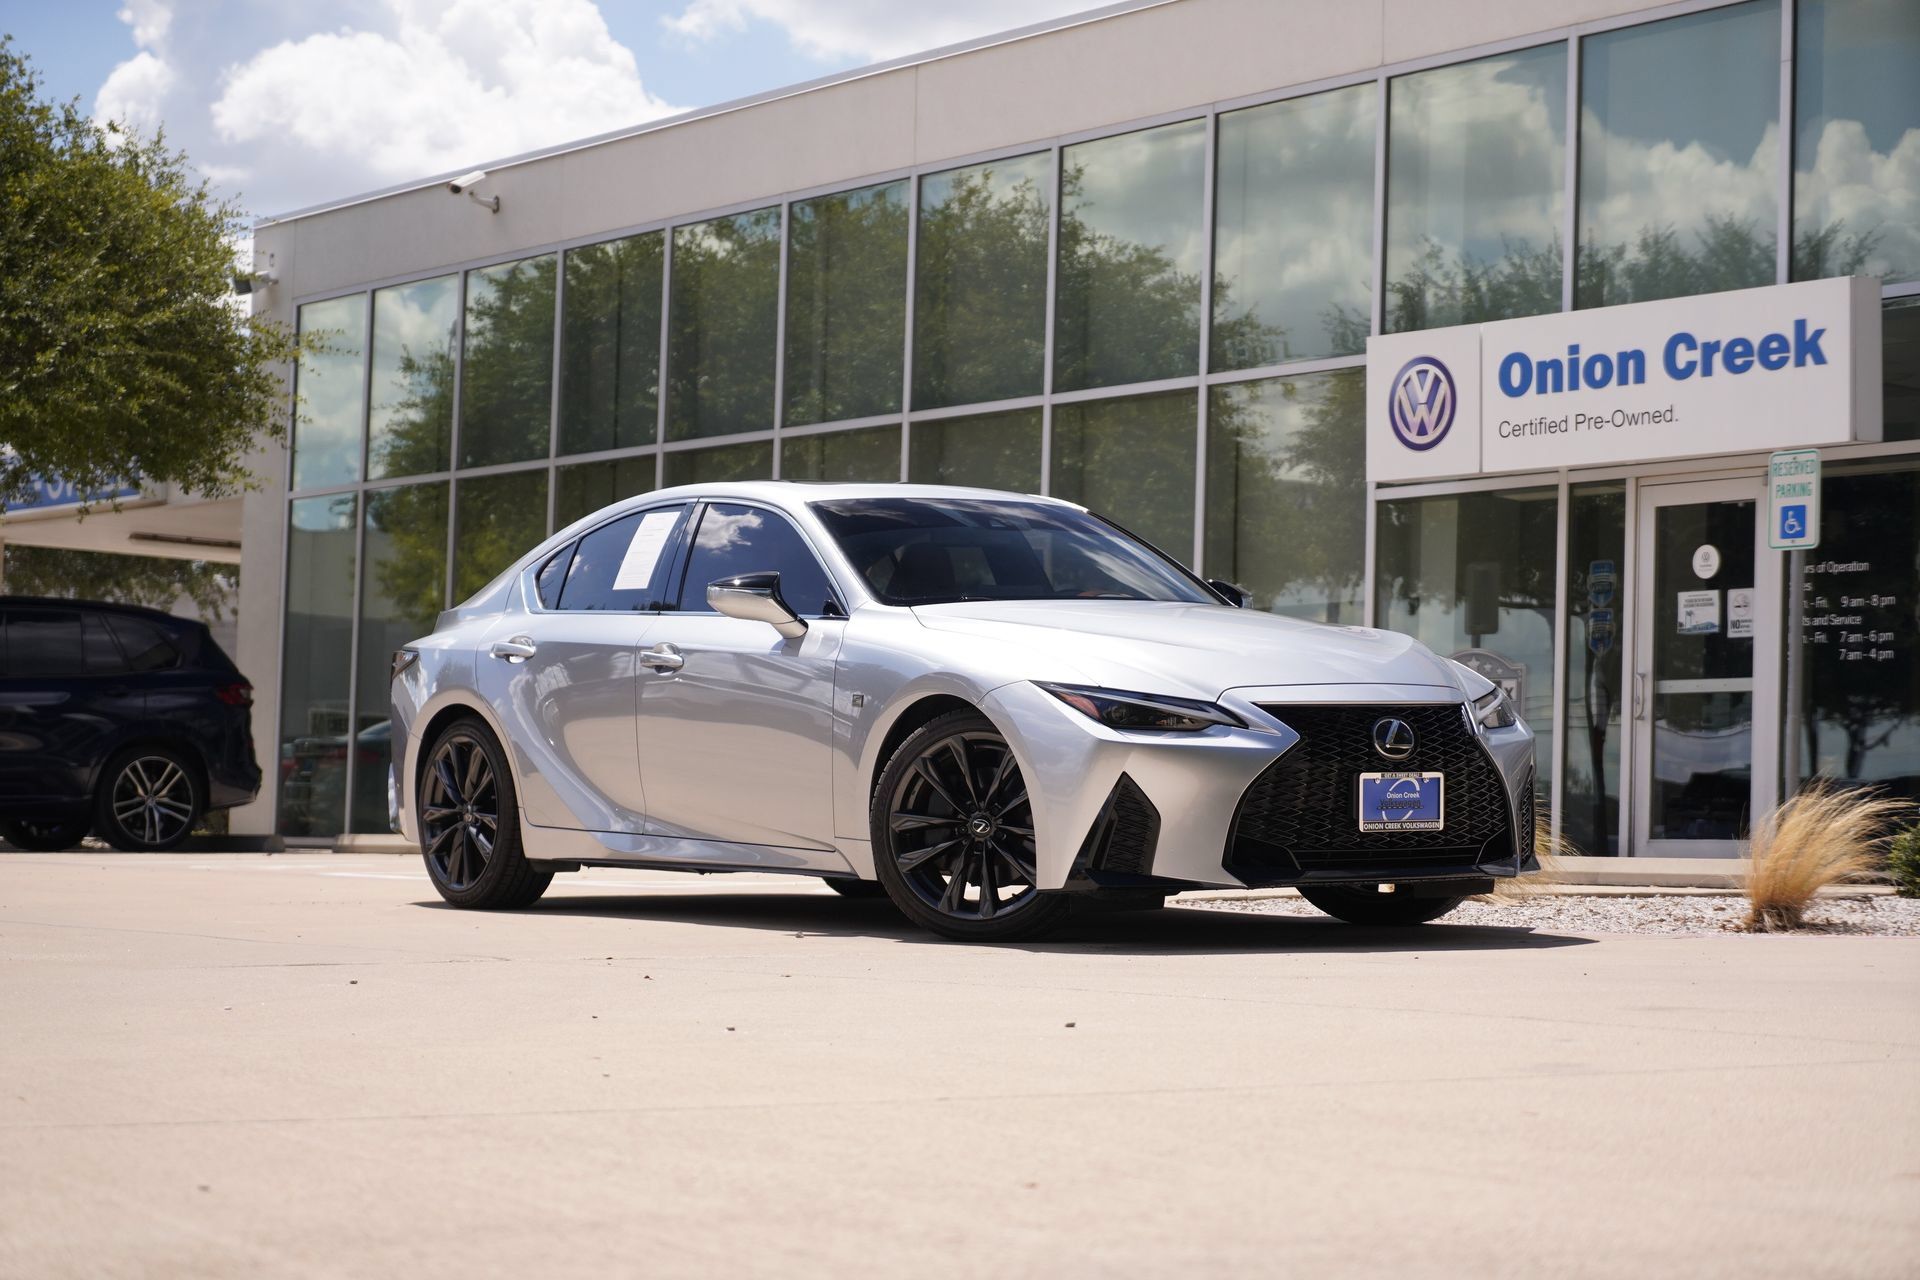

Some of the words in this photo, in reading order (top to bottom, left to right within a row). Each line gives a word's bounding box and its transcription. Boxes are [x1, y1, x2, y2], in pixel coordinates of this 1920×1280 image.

[1498, 344, 1646, 398] Onion
[1662, 318, 1829, 381] Creek
[1498, 415, 1568, 438] Certified
[1574, 404, 1679, 431] Pre-Owned.
[1772, 459, 1816, 477] RESERVED
[1775, 482, 1812, 498] PARKING
[1827, 561, 1870, 575] Operation
[1812, 614, 1829, 625] and
[1829, 613, 1862, 625] Service
[1403, 791, 1420, 799] Creek
